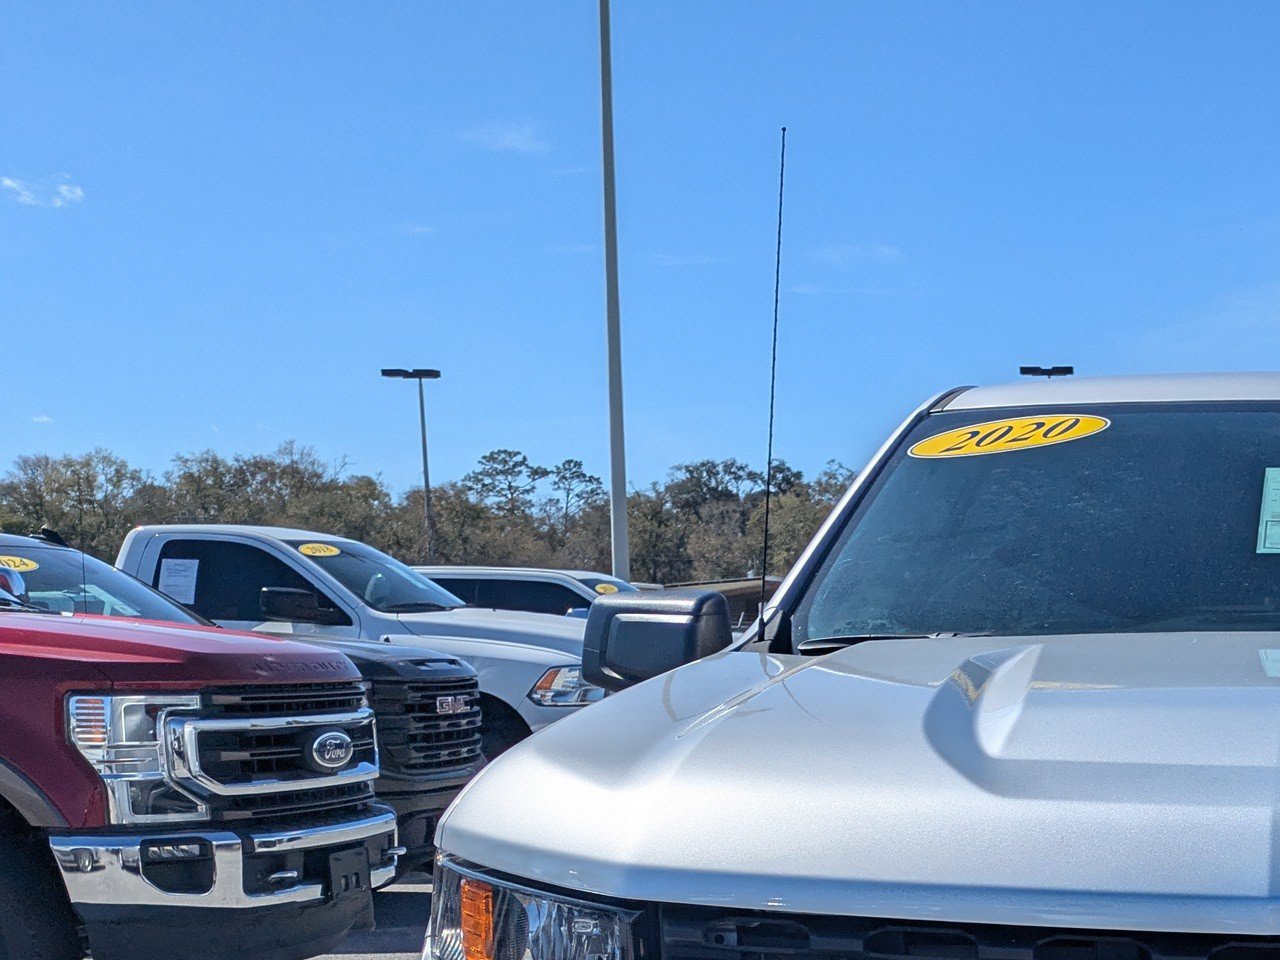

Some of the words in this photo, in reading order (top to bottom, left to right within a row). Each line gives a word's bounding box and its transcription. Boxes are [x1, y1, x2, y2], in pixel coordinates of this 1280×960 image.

[938, 417, 1080, 454] 2020
[436, 695, 471, 714] GMC
[324, 739, 346, 760] Ford
